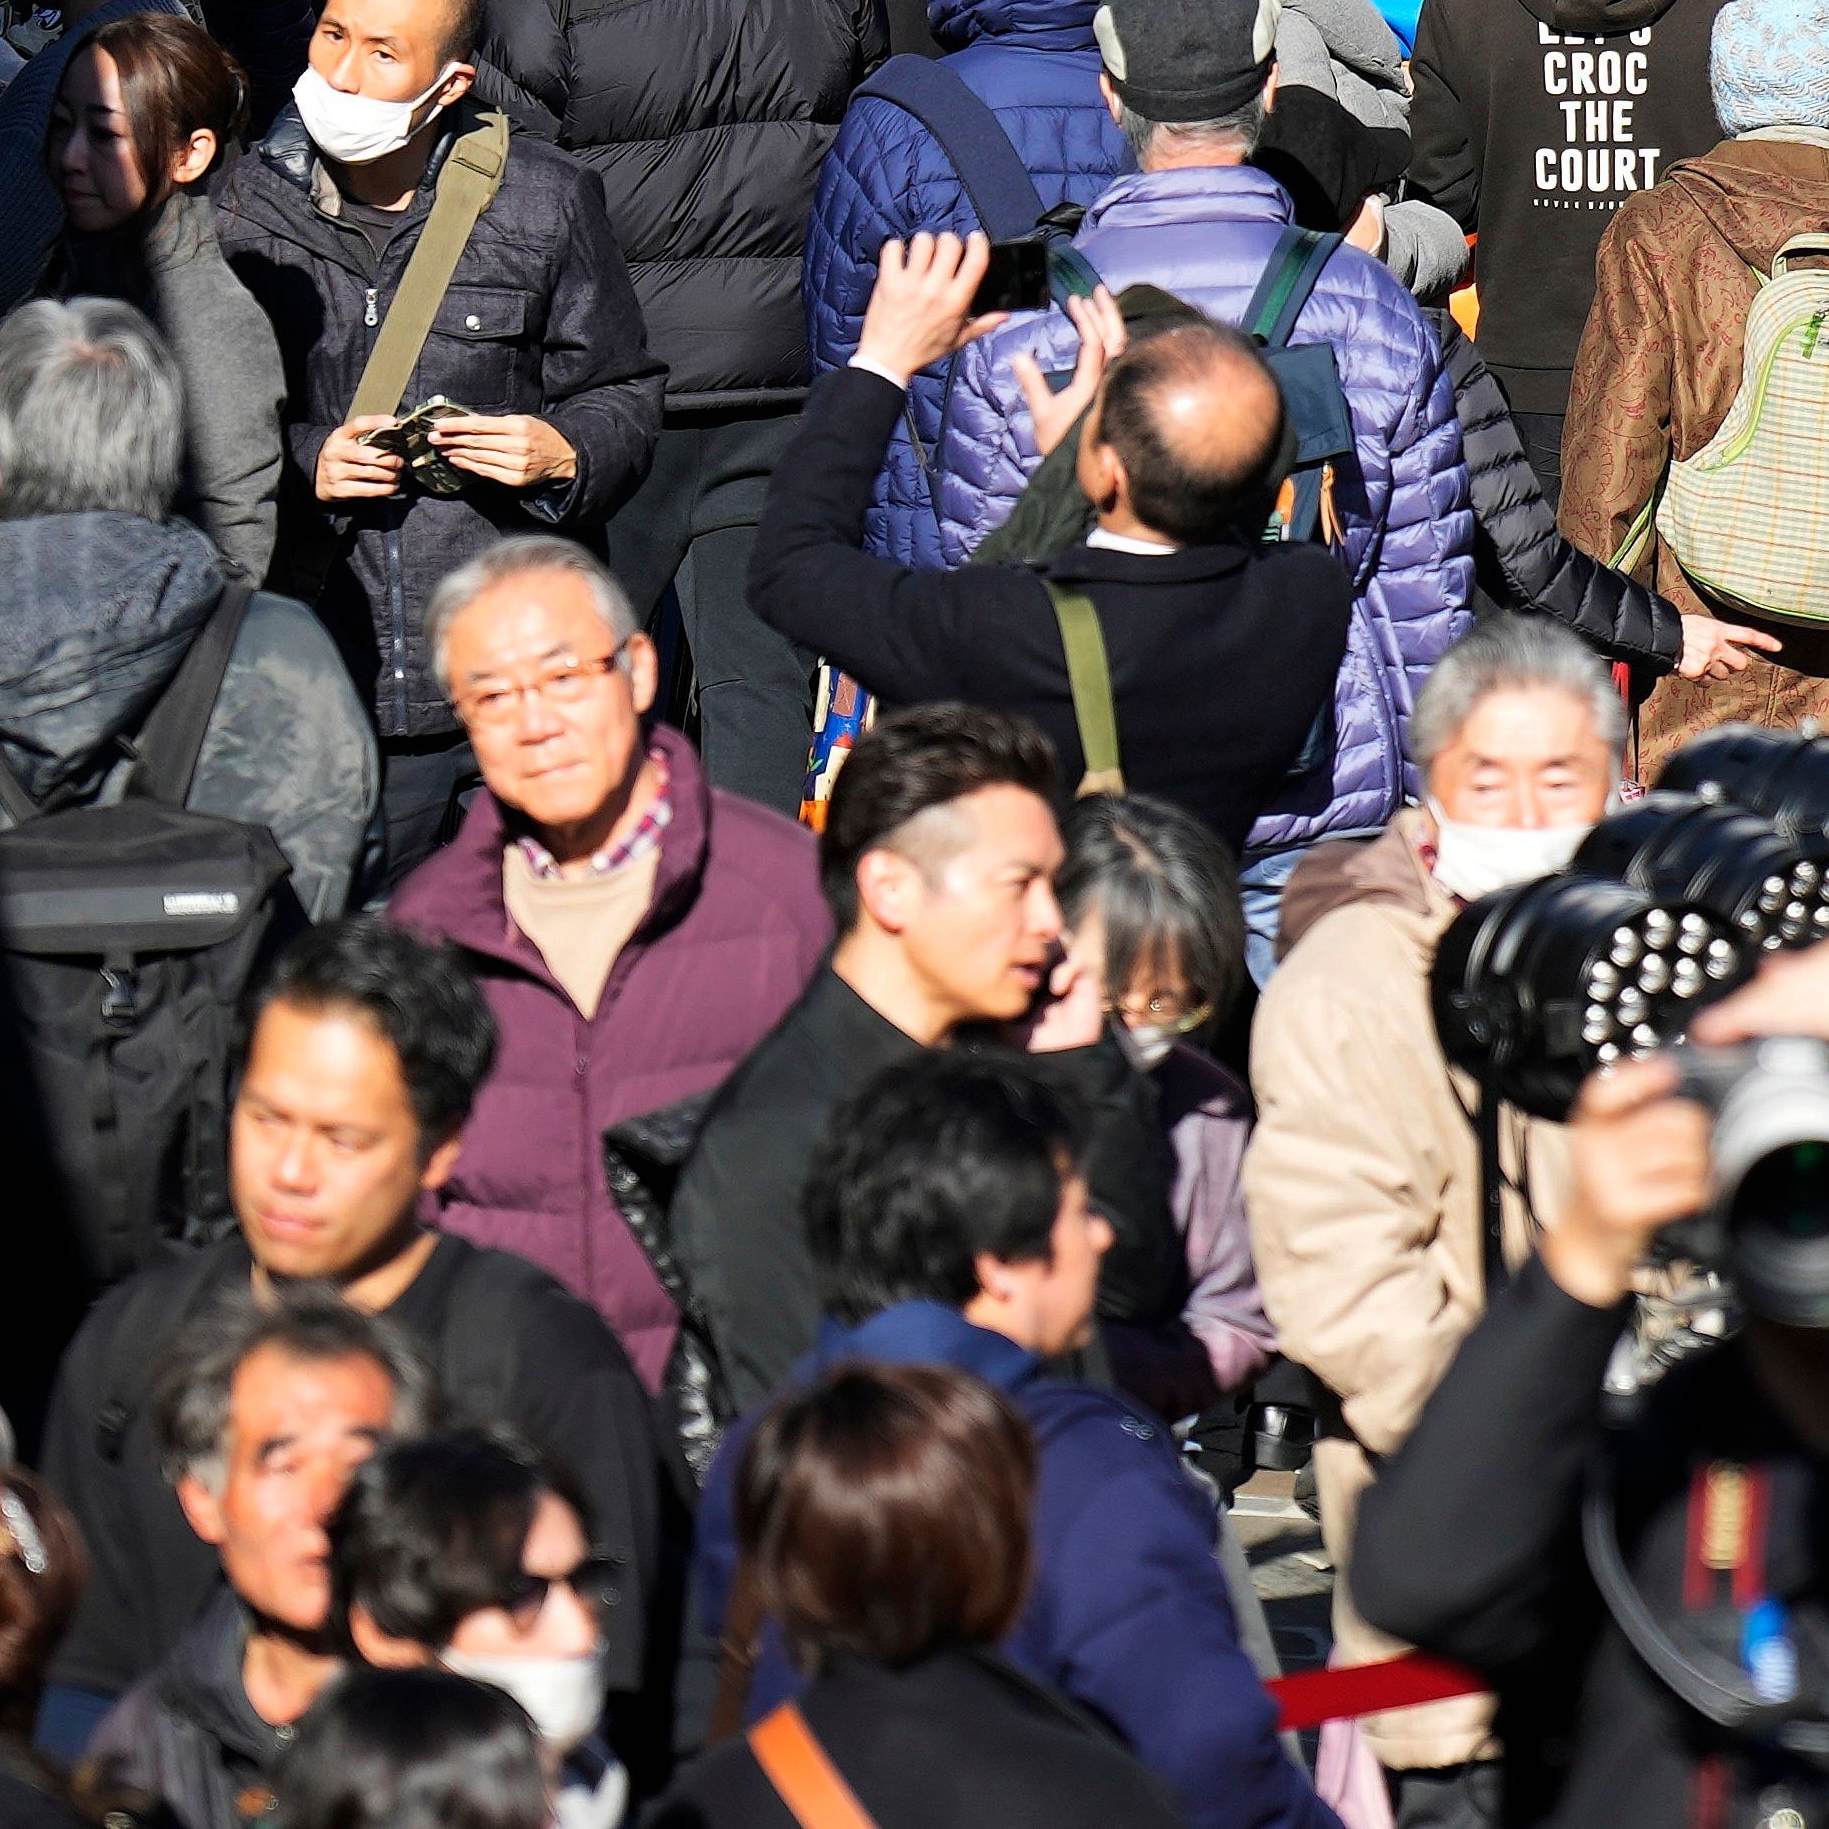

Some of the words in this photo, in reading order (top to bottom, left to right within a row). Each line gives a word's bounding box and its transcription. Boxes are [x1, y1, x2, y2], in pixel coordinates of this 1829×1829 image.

[1544, 50, 1648, 95] CROC
[1559, 100, 1634, 142] THE
[1535, 148, 1660, 192] COURT
